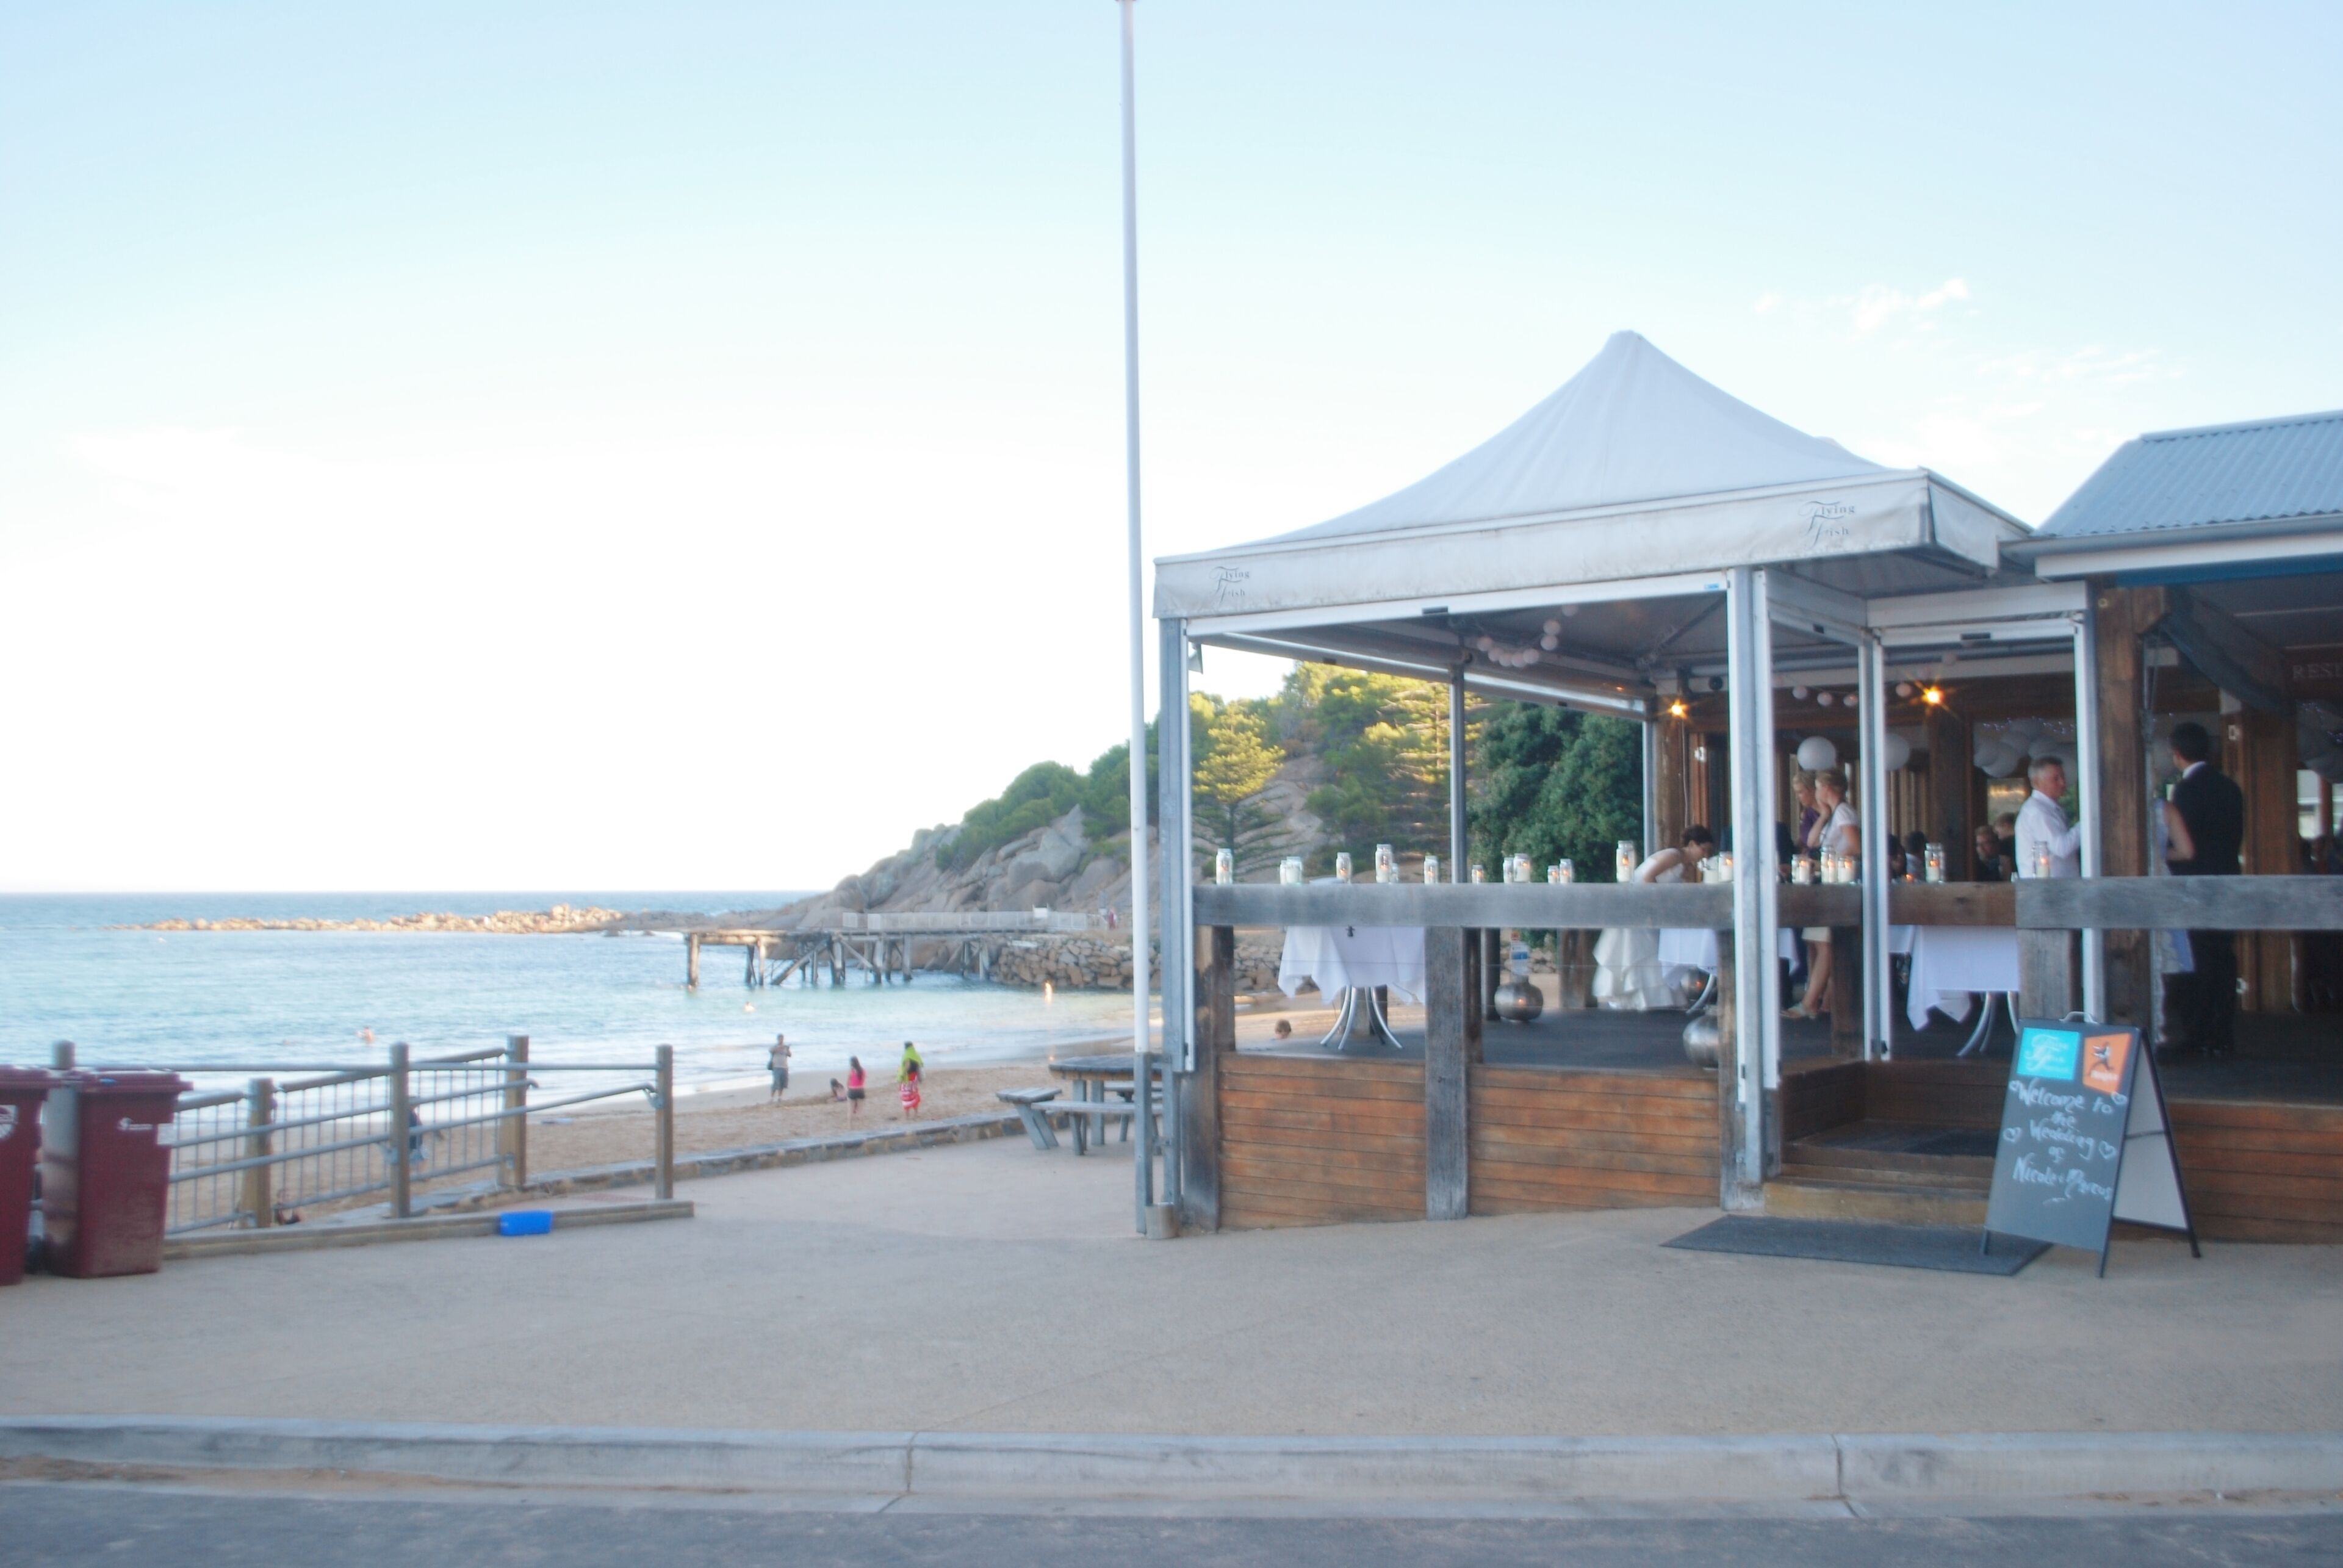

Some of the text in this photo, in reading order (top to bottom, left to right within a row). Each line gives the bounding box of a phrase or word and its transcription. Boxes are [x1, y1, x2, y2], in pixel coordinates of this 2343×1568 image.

[1798, 500, 1855, 536] Flying
[1803, 515, 1849, 548] Fish
[1209, 566, 1250, 595] Flying
[1214, 578, 1245, 605] Fish
[2018, 1077, 2113, 1114] Welcome to
[2050, 1110, 2079, 1132] the
[2029, 1118, 2095, 1160] Wedding
